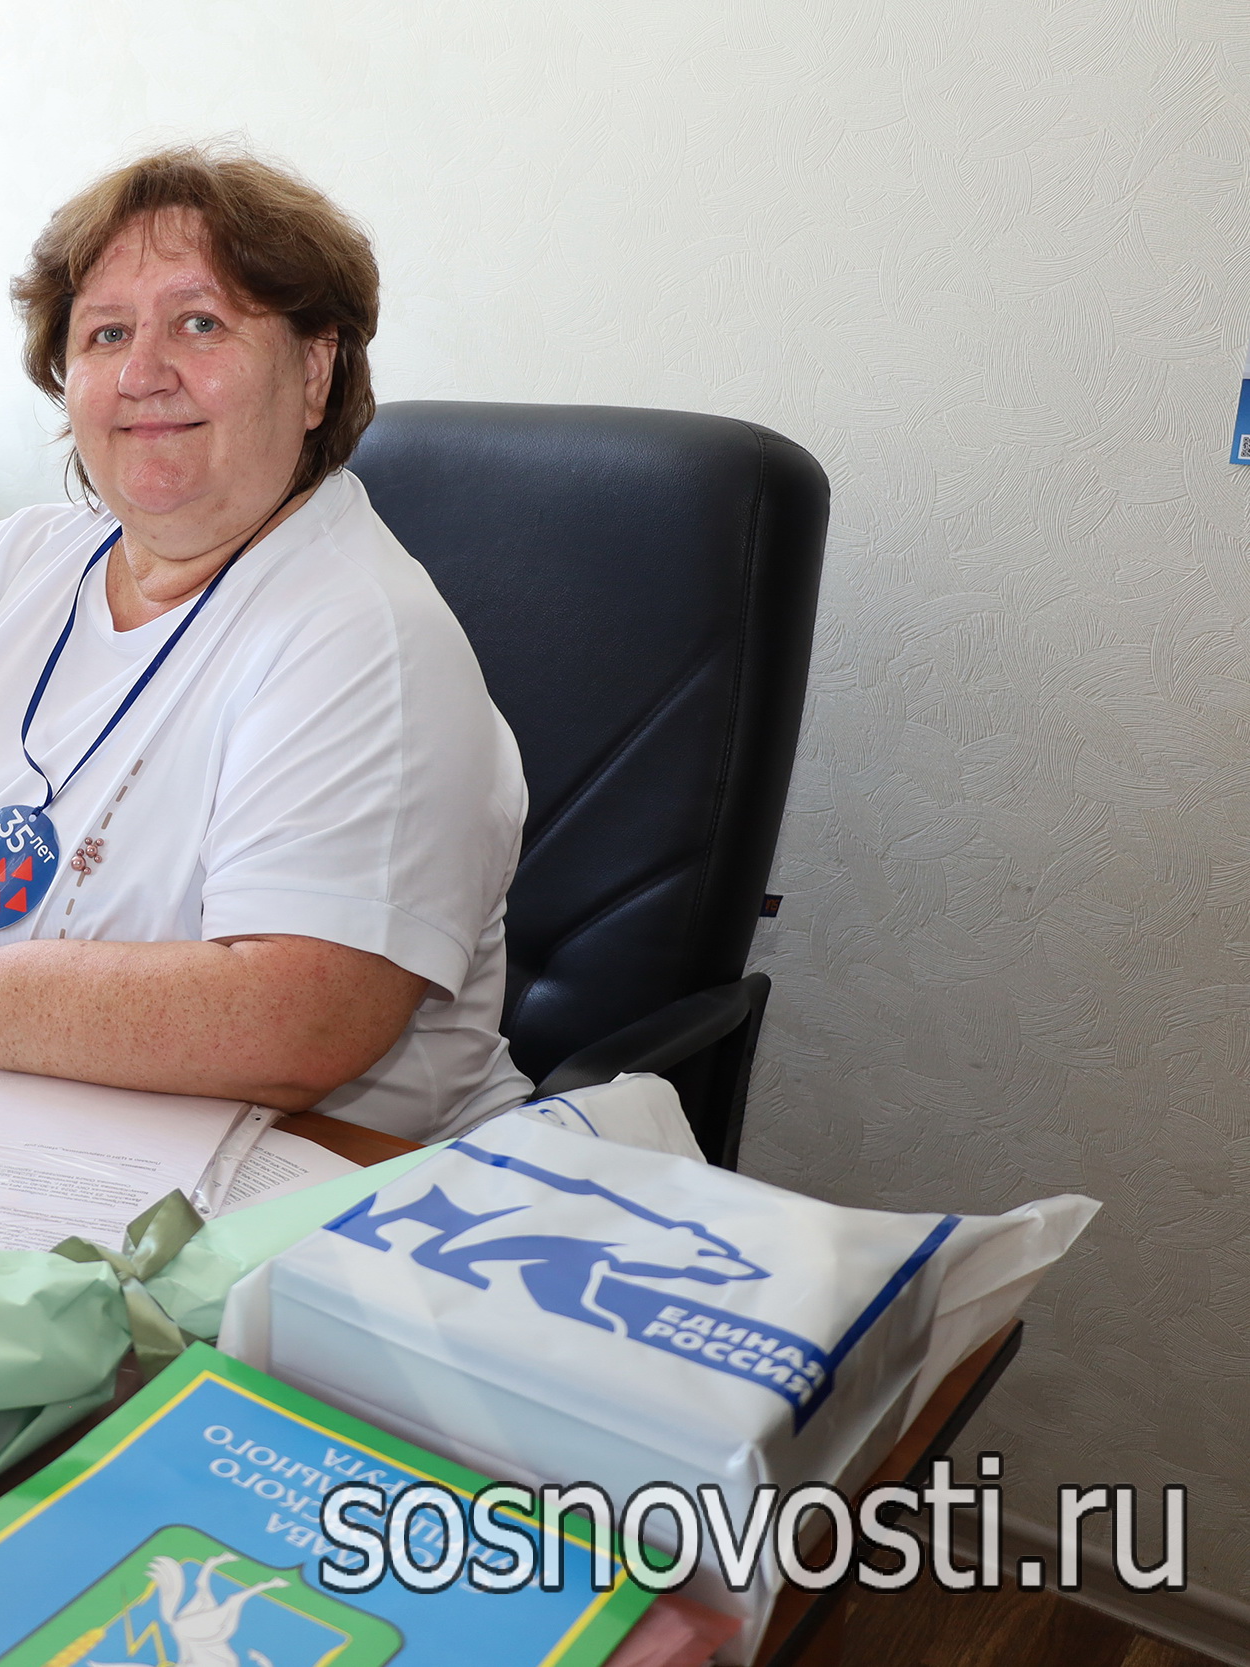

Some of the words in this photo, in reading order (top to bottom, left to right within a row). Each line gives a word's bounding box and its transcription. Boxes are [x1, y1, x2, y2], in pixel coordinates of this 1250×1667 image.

[29, 836, 56, 863] лет
[642, 1320, 814, 1407] РОССИЯ
[657, 1305, 826, 1388] ЕДИНАЯ
